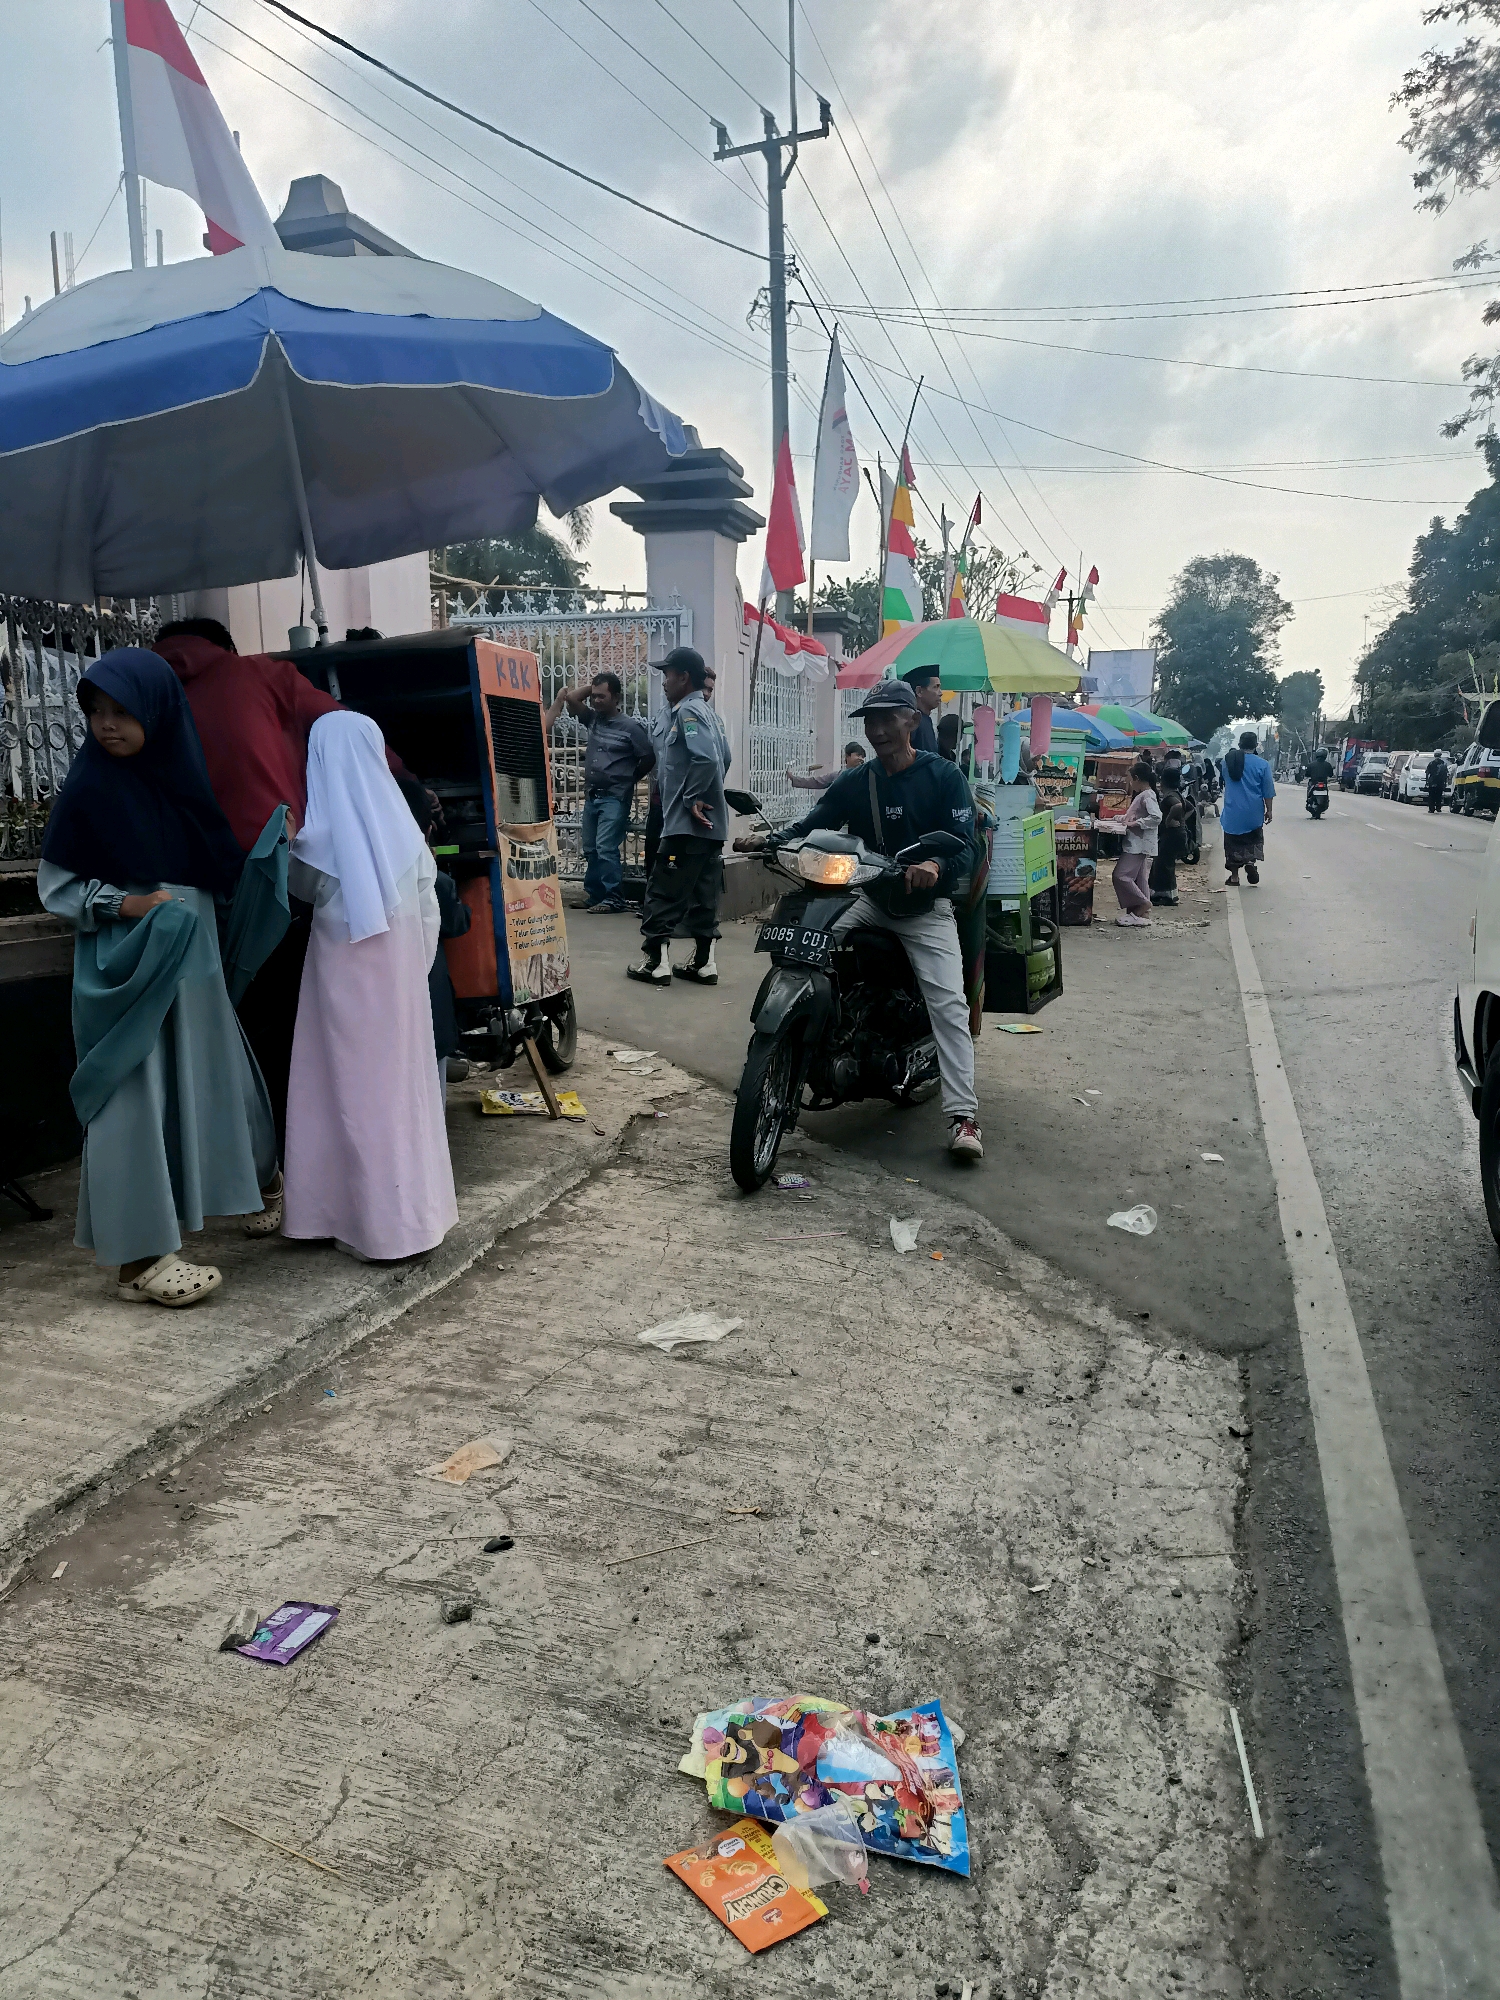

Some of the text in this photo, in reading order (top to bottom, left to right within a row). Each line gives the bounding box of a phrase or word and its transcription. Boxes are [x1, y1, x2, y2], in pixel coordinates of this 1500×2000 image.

[494, 652, 531, 692] KBK
[1057, 843, 1089, 851] KARAN
[506, 855, 557, 880] GULUNG
[763, 926, 796, 942] 3085
[721, 1873, 766, 1901] potato twister
[722, 1874, 790, 1923] CRUNCHY
